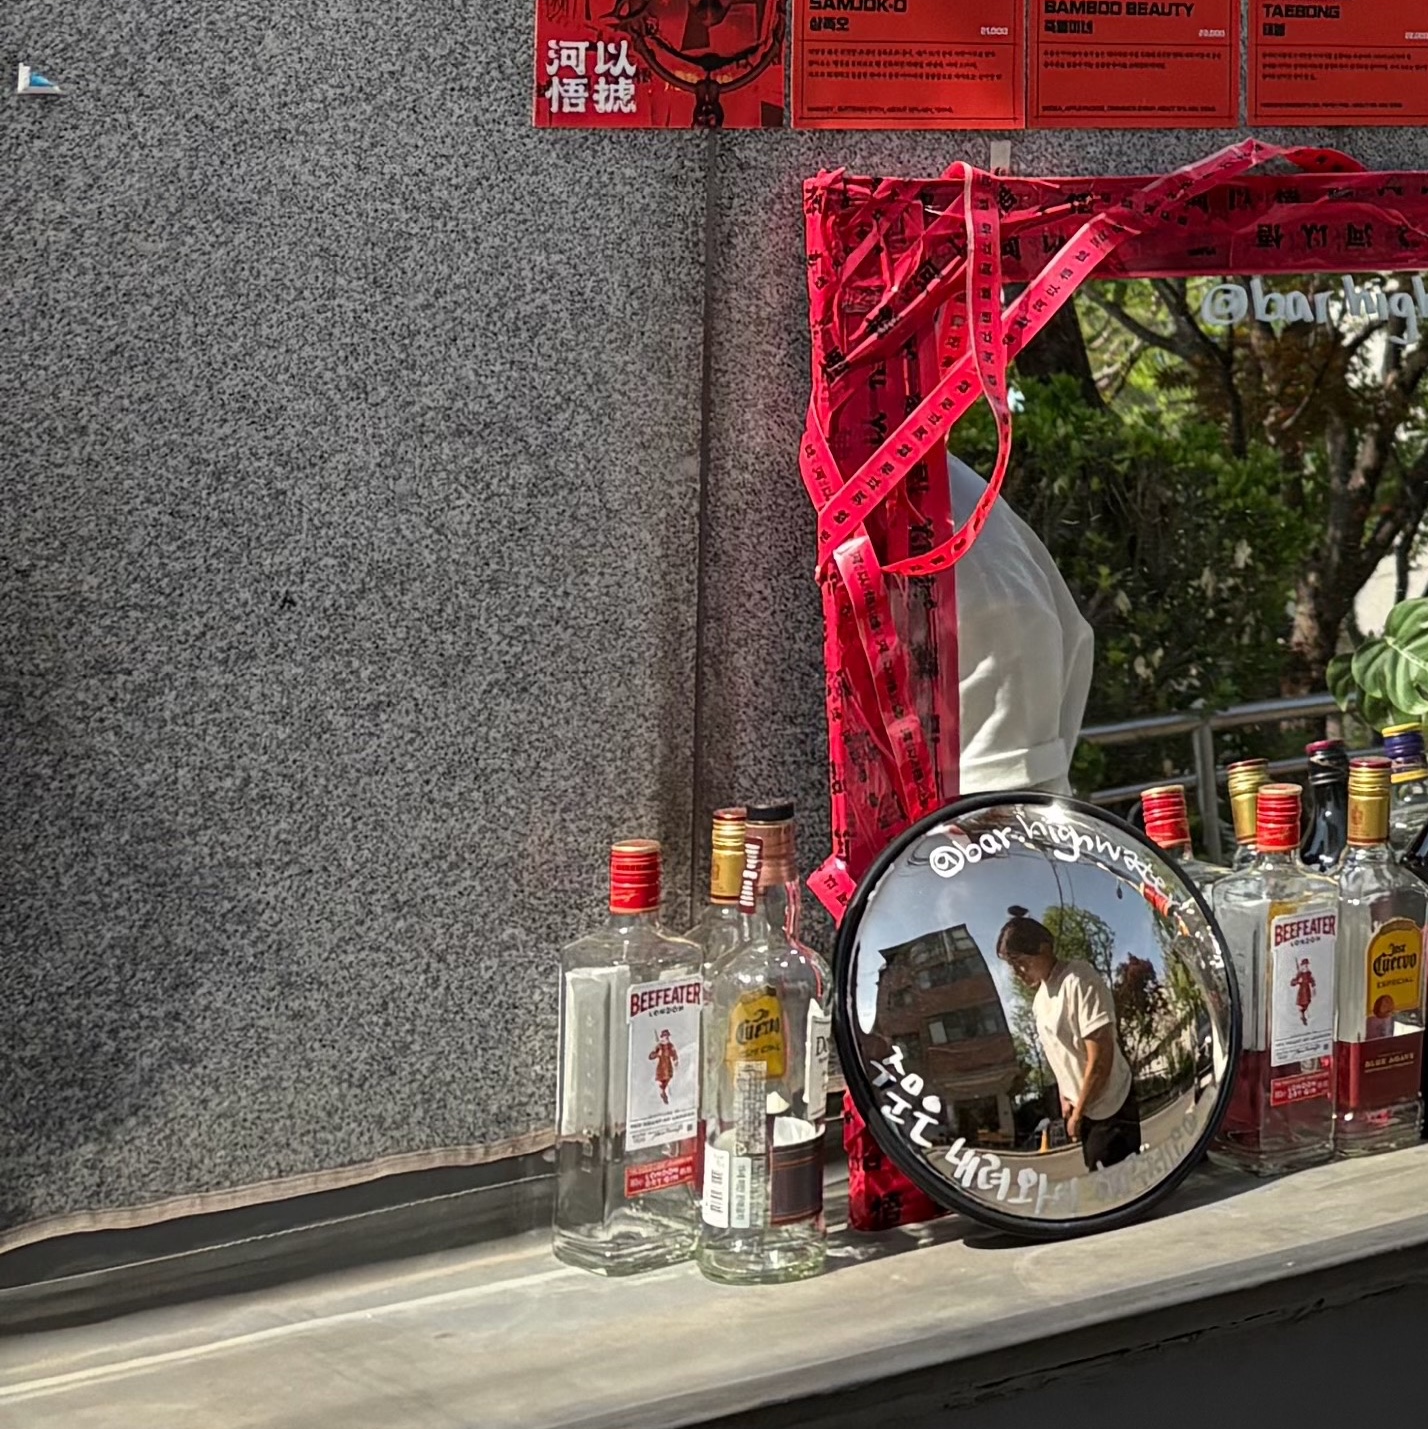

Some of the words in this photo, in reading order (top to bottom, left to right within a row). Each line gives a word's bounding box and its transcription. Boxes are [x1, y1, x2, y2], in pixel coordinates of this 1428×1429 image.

[1044, 0, 1122, 16] BAMBOO
[1126, 1, 1195, 17] BEAUTY
[1262, 4, 1340, 19] TAEBONG
[1274, 915, 1336, 947] BEEFEATER
[1290, 936, 1321, 947] LONDON
[1373, 953, 1418, 977] Cuervo
[1376, 978, 1414, 989] ESPECIAL
[630, 981, 701, 1017] BEEFEATER
[648, 1005, 684, 1018] LONDON
[1364, 1058, 1387, 1068] BLUE
[1389, 1052, 1415, 1065] AGAVE
